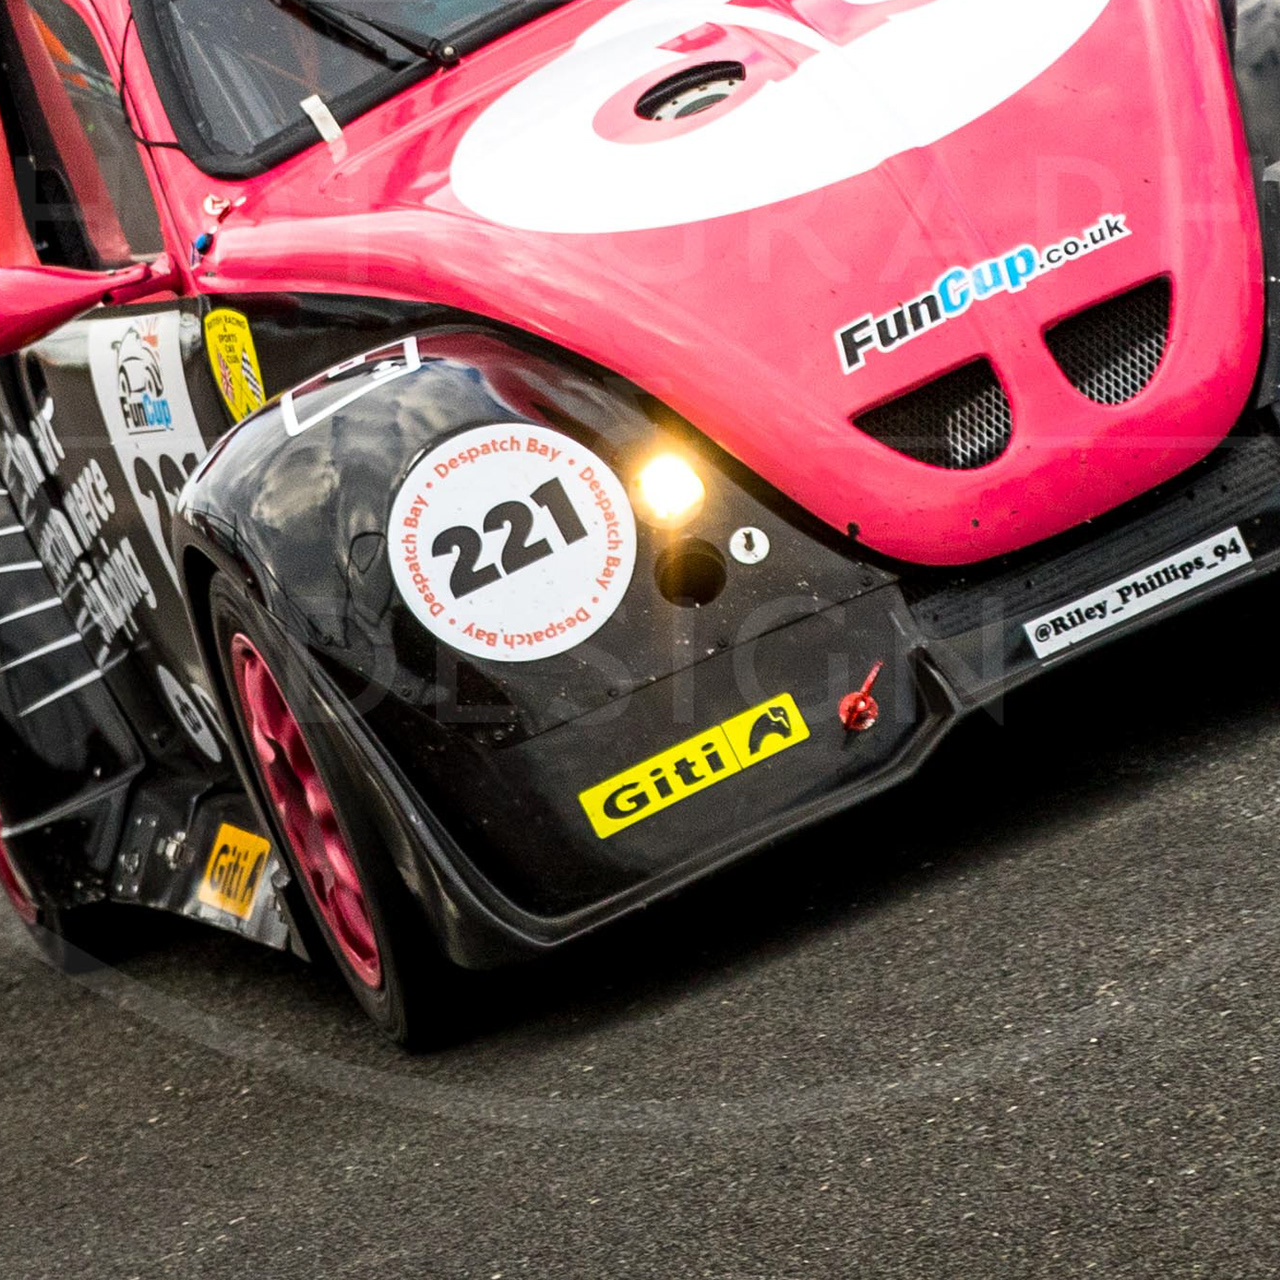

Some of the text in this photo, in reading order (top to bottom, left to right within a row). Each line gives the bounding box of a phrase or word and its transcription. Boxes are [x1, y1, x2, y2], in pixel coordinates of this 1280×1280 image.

[834, 214, 1131, 374] FunCup.co.uk
[119, 392, 172, 431] FunCup
[433, 436, 562, 479] Despatch Bay
[401, 494, 446, 618] Despatch Bay
[431, 476, 589, 600] 221
[578, 466, 624, 591] Despatch Bay
[462, 606, 592, 650] Despatch Bay
[1034, 537, 1242, 643] @Riley_Phillips_94
[602, 742, 725, 820] Giti
[209, 843, 248, 900] Giti
